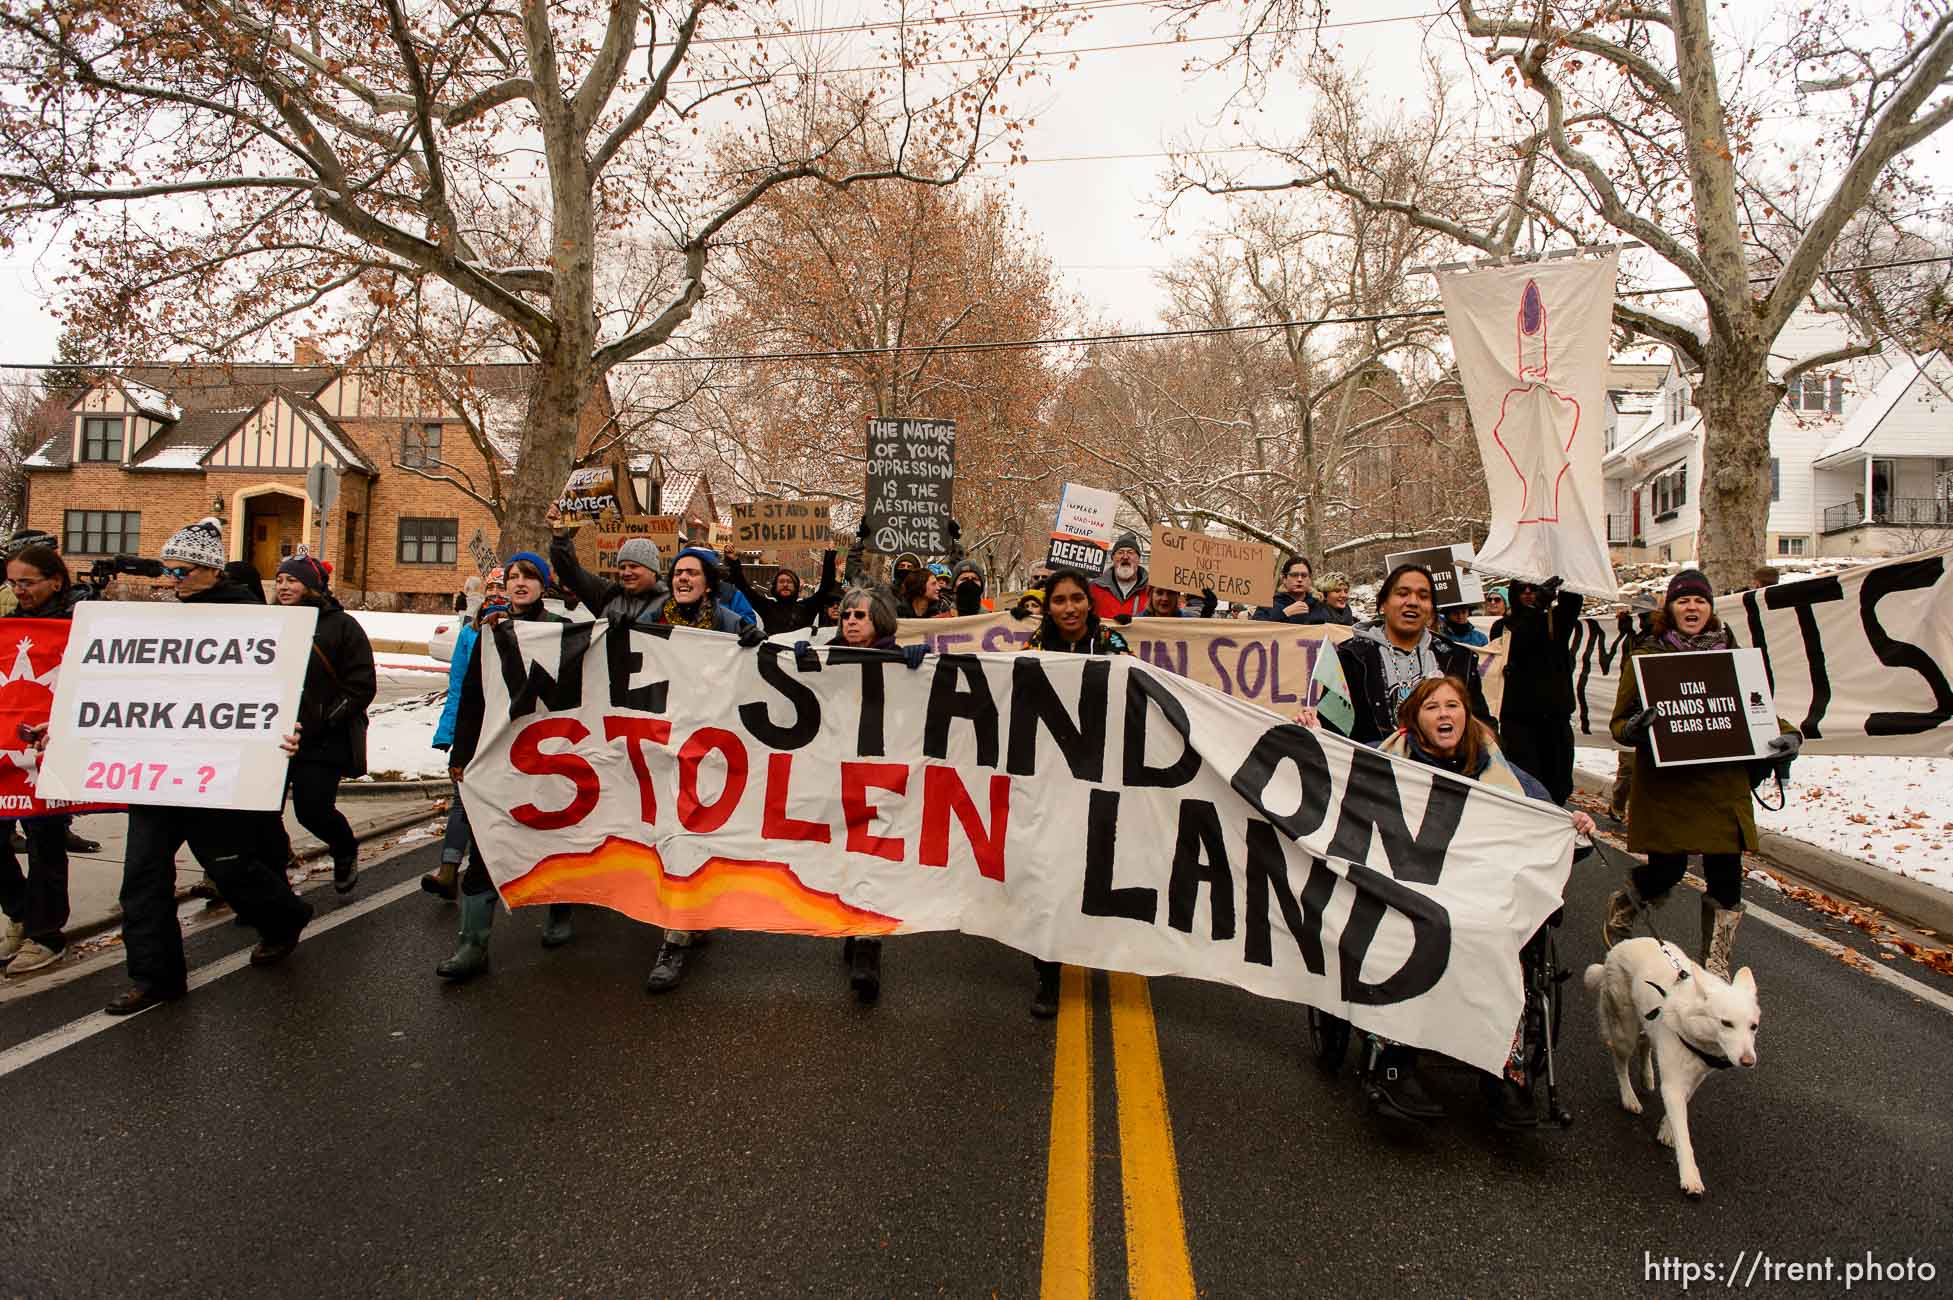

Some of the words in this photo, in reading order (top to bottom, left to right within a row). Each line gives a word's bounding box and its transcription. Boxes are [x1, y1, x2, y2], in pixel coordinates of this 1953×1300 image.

[868, 420, 898, 440] THE
[903, 420, 956, 445] NATURE
[875, 444, 899, 457] OF
[906, 443, 950, 463] YOUR
[866, 459, 953, 479] OPPRESSION
[883, 480, 898, 498] IS
[907, 483, 941, 500] THE
[559, 495, 614, 512] PROTECT
[735, 503, 756, 518] WE
[763, 503, 809, 518] STAND
[873, 497, 950, 516] AESTHETIC
[1066, 504, 1098, 515] IMPEACH
[625, 523, 648, 533] YOUR
[649, 519, 676, 532] TINY
[740, 523, 796, 541] STOLEN
[888, 516, 908, 528] OF
[912, 516, 940, 530] OUR
[1065, 525, 1094, 537] TRUMP
[875, 527, 946, 552] ANGER
[1161, 532, 1188, 551] GUT
[1193, 540, 1264, 561] CAPITALISM
[1052, 541, 1104, 566] DEFEND
[1196, 557, 1222, 570] NOT
[1174, 566, 1216, 591] BEARS
[1218, 575, 1252, 596] EARS
[82, 638, 277, 665] AMERICA'S
[1680, 681, 1707, 696] UTAH
[78, 702, 178, 729] DARK
[182, 702, 279, 730] AGE?
[1656, 697, 1705, 717] STANDS
[1707, 696, 1737, 713] WITH
[1670, 718, 1704, 733] BEARS
[1705, 716, 1732, 731] EARS
[492, 619, 673, 721] WE
[739, 640, 1203, 787] STAND
[1231, 724, 1472, 885] ON
[509, 716, 1010, 882] STOLEN
[1082, 789, 1452, 1006] LAND
